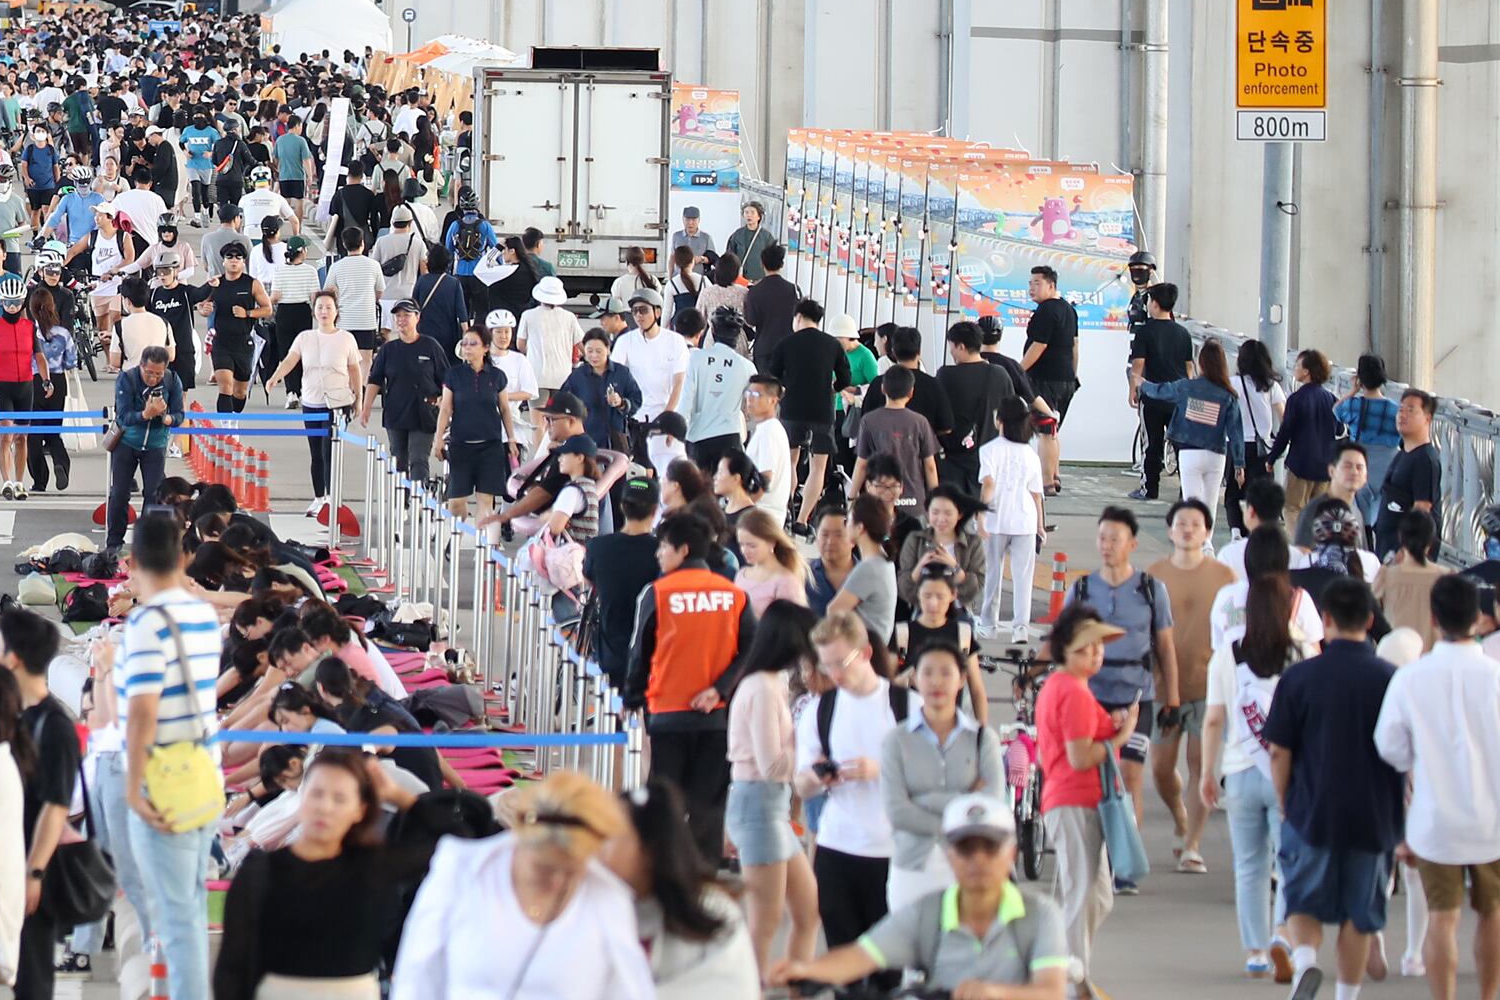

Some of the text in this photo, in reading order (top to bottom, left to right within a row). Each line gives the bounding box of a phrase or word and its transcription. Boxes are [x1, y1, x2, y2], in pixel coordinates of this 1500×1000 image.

[1247, 29, 1315, 54] 단속중
[1254, 62, 1308, 78] Photo
[1243, 82, 1319, 95] enforcement
[1253, 116, 1309, 138] 800m
[695, 176, 714, 184] IPX
[98, 247, 114, 257] NIKE
[560, 258, 588, 267] 6970
[707, 356, 733, 368] P N
[715, 373, 724, 383] S
[669, 590, 734, 615] STAFF
